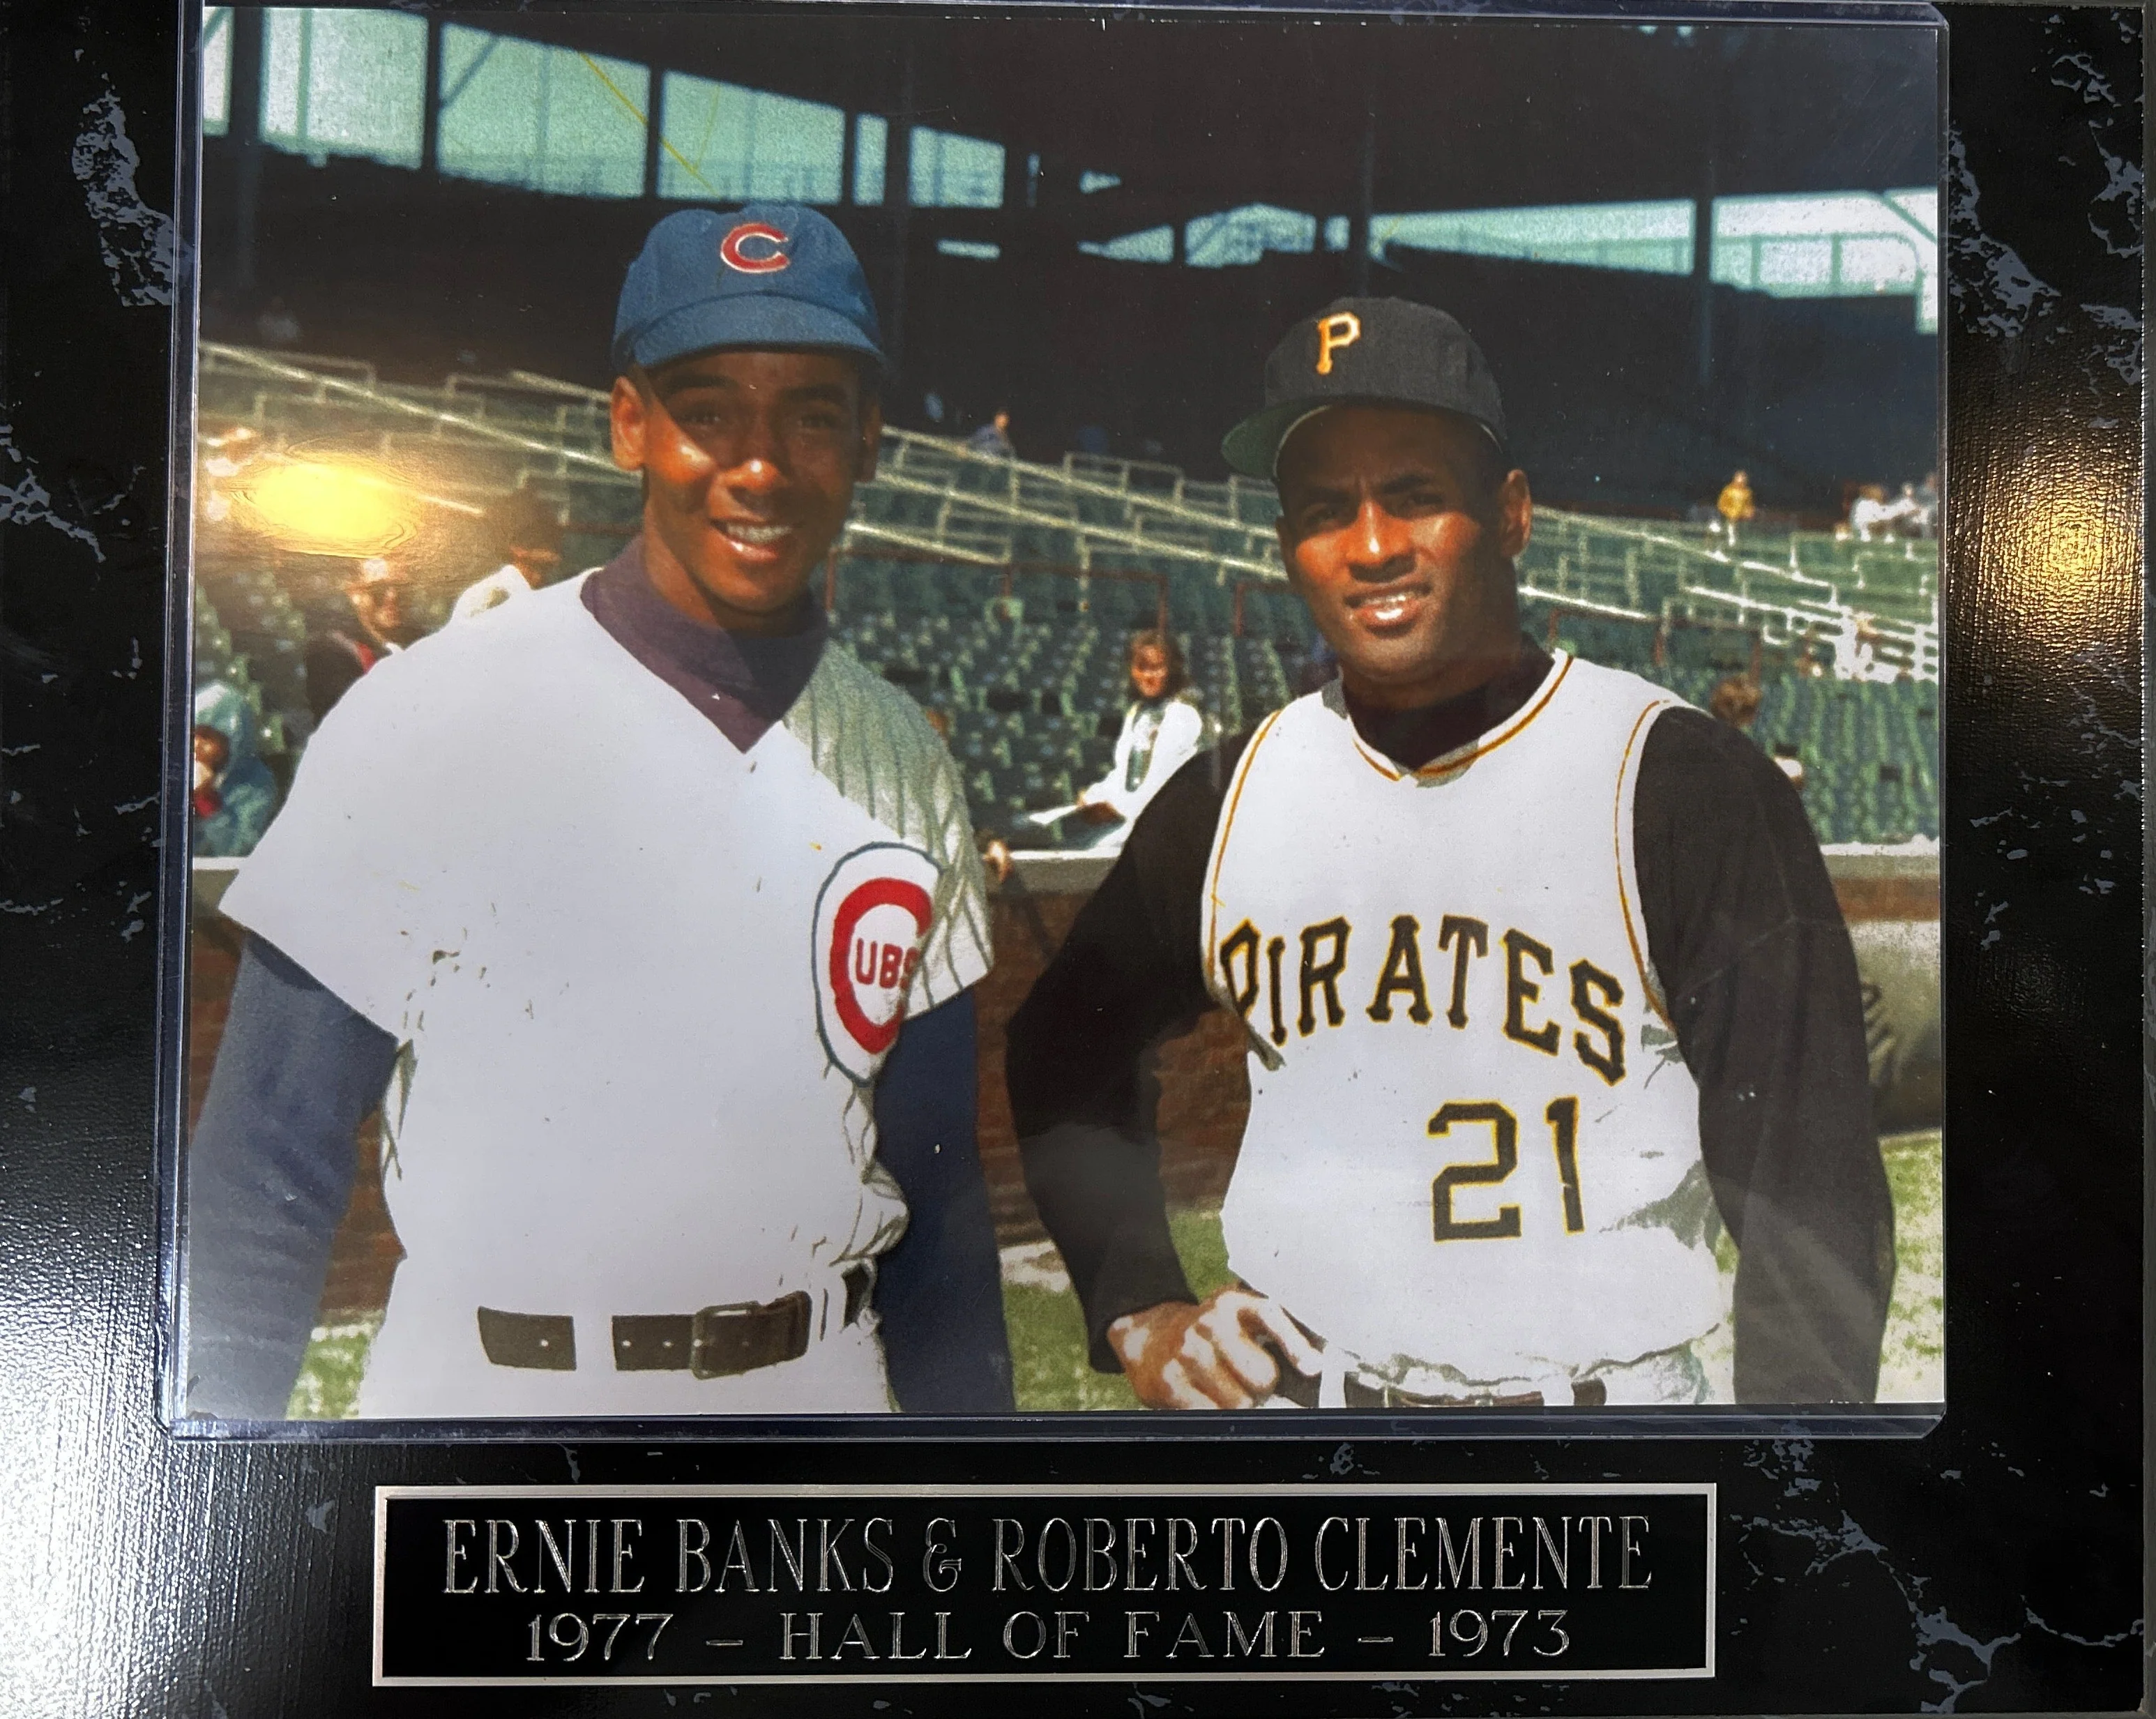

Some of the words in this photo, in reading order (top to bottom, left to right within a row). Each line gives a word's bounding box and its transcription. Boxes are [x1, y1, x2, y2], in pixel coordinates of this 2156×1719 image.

[720, 222, 791, 273] C
[1316, 311, 1360, 375] P
[1219, 914, 1626, 1086] PIRATES
[1426, 1095, 1584, 1242] 21
[442, 1519, 646, 1594] ERNIE
[674, 1517, 894, 1593] BANKS
[923, 1517, 962, 1593] &
[992, 1517, 1288, 1592] ROBERTO
[1314, 1516, 1653, 1591] CLEMENTE
[526, 1611, 674, 1662] 1977
[779, 1610, 972, 1660] HALL
[1002, 1610, 1089, 1659] OF
[1123, 1610, 1326, 1658] FAME
[1428, 1608, 1570, 1658] 1973
